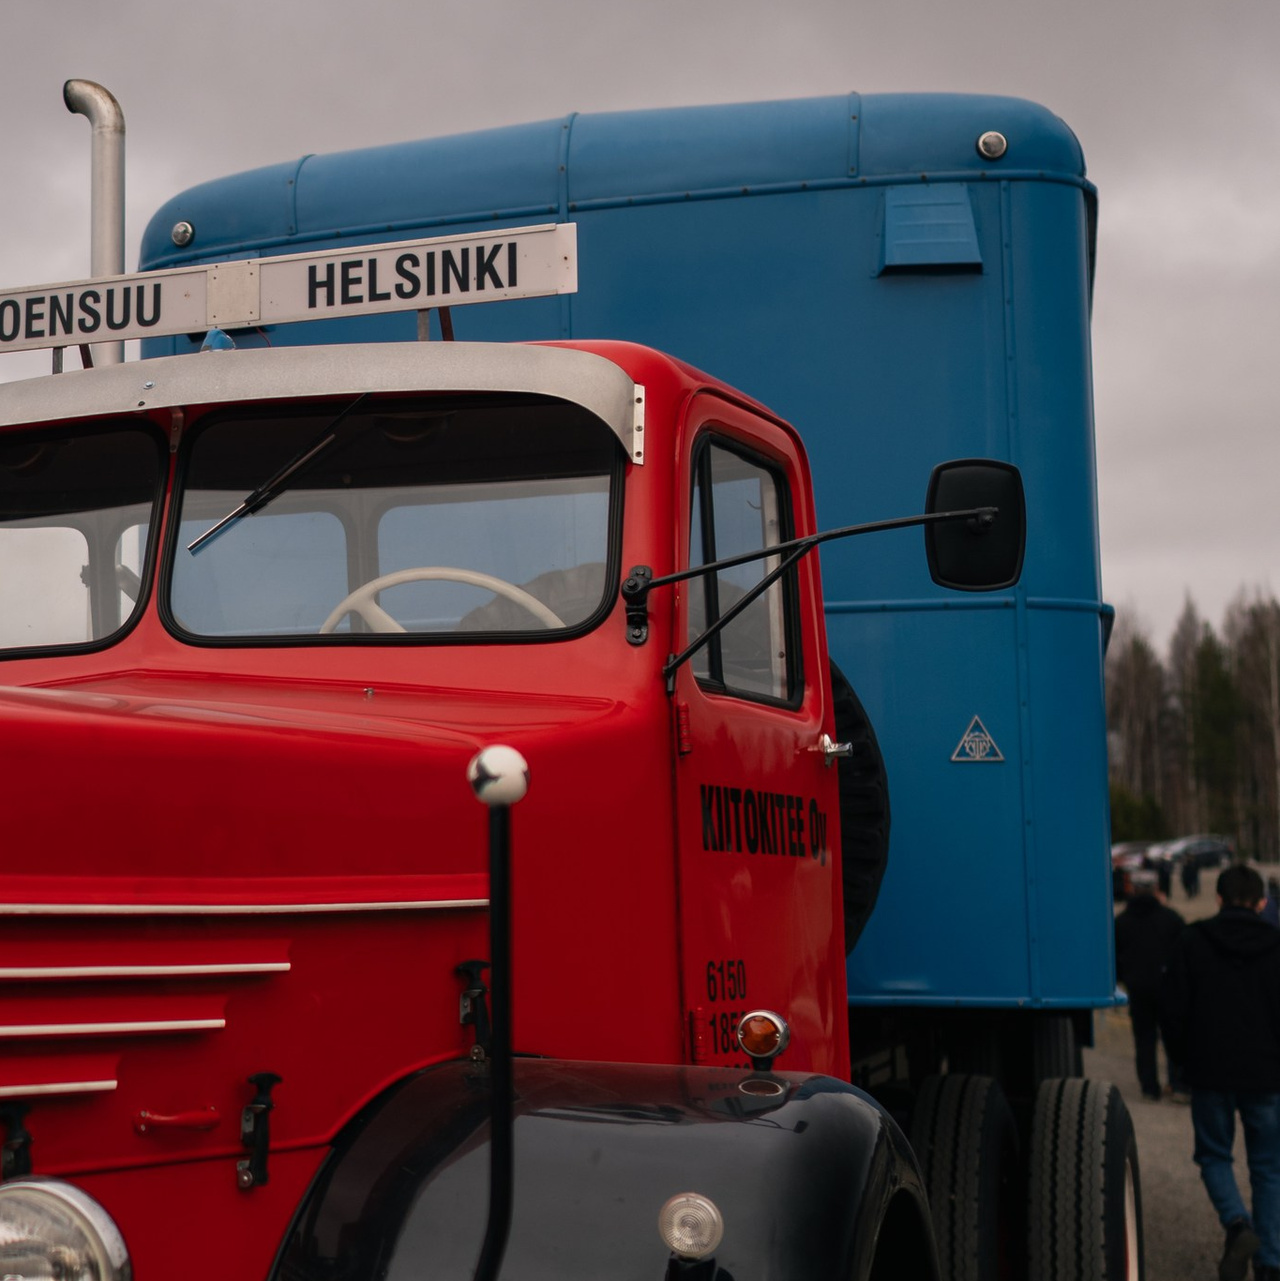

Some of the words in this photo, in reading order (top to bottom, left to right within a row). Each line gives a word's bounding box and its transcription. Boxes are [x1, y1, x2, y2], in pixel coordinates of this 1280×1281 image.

[307, 242, 518, 308] HELSINKI
[700, 783, 806, 857] KIITOKITEE
[809, 797, 827, 867] Oy
[706, 959, 746, 1002] 6150
[709, 1011, 746, 1055] 185
